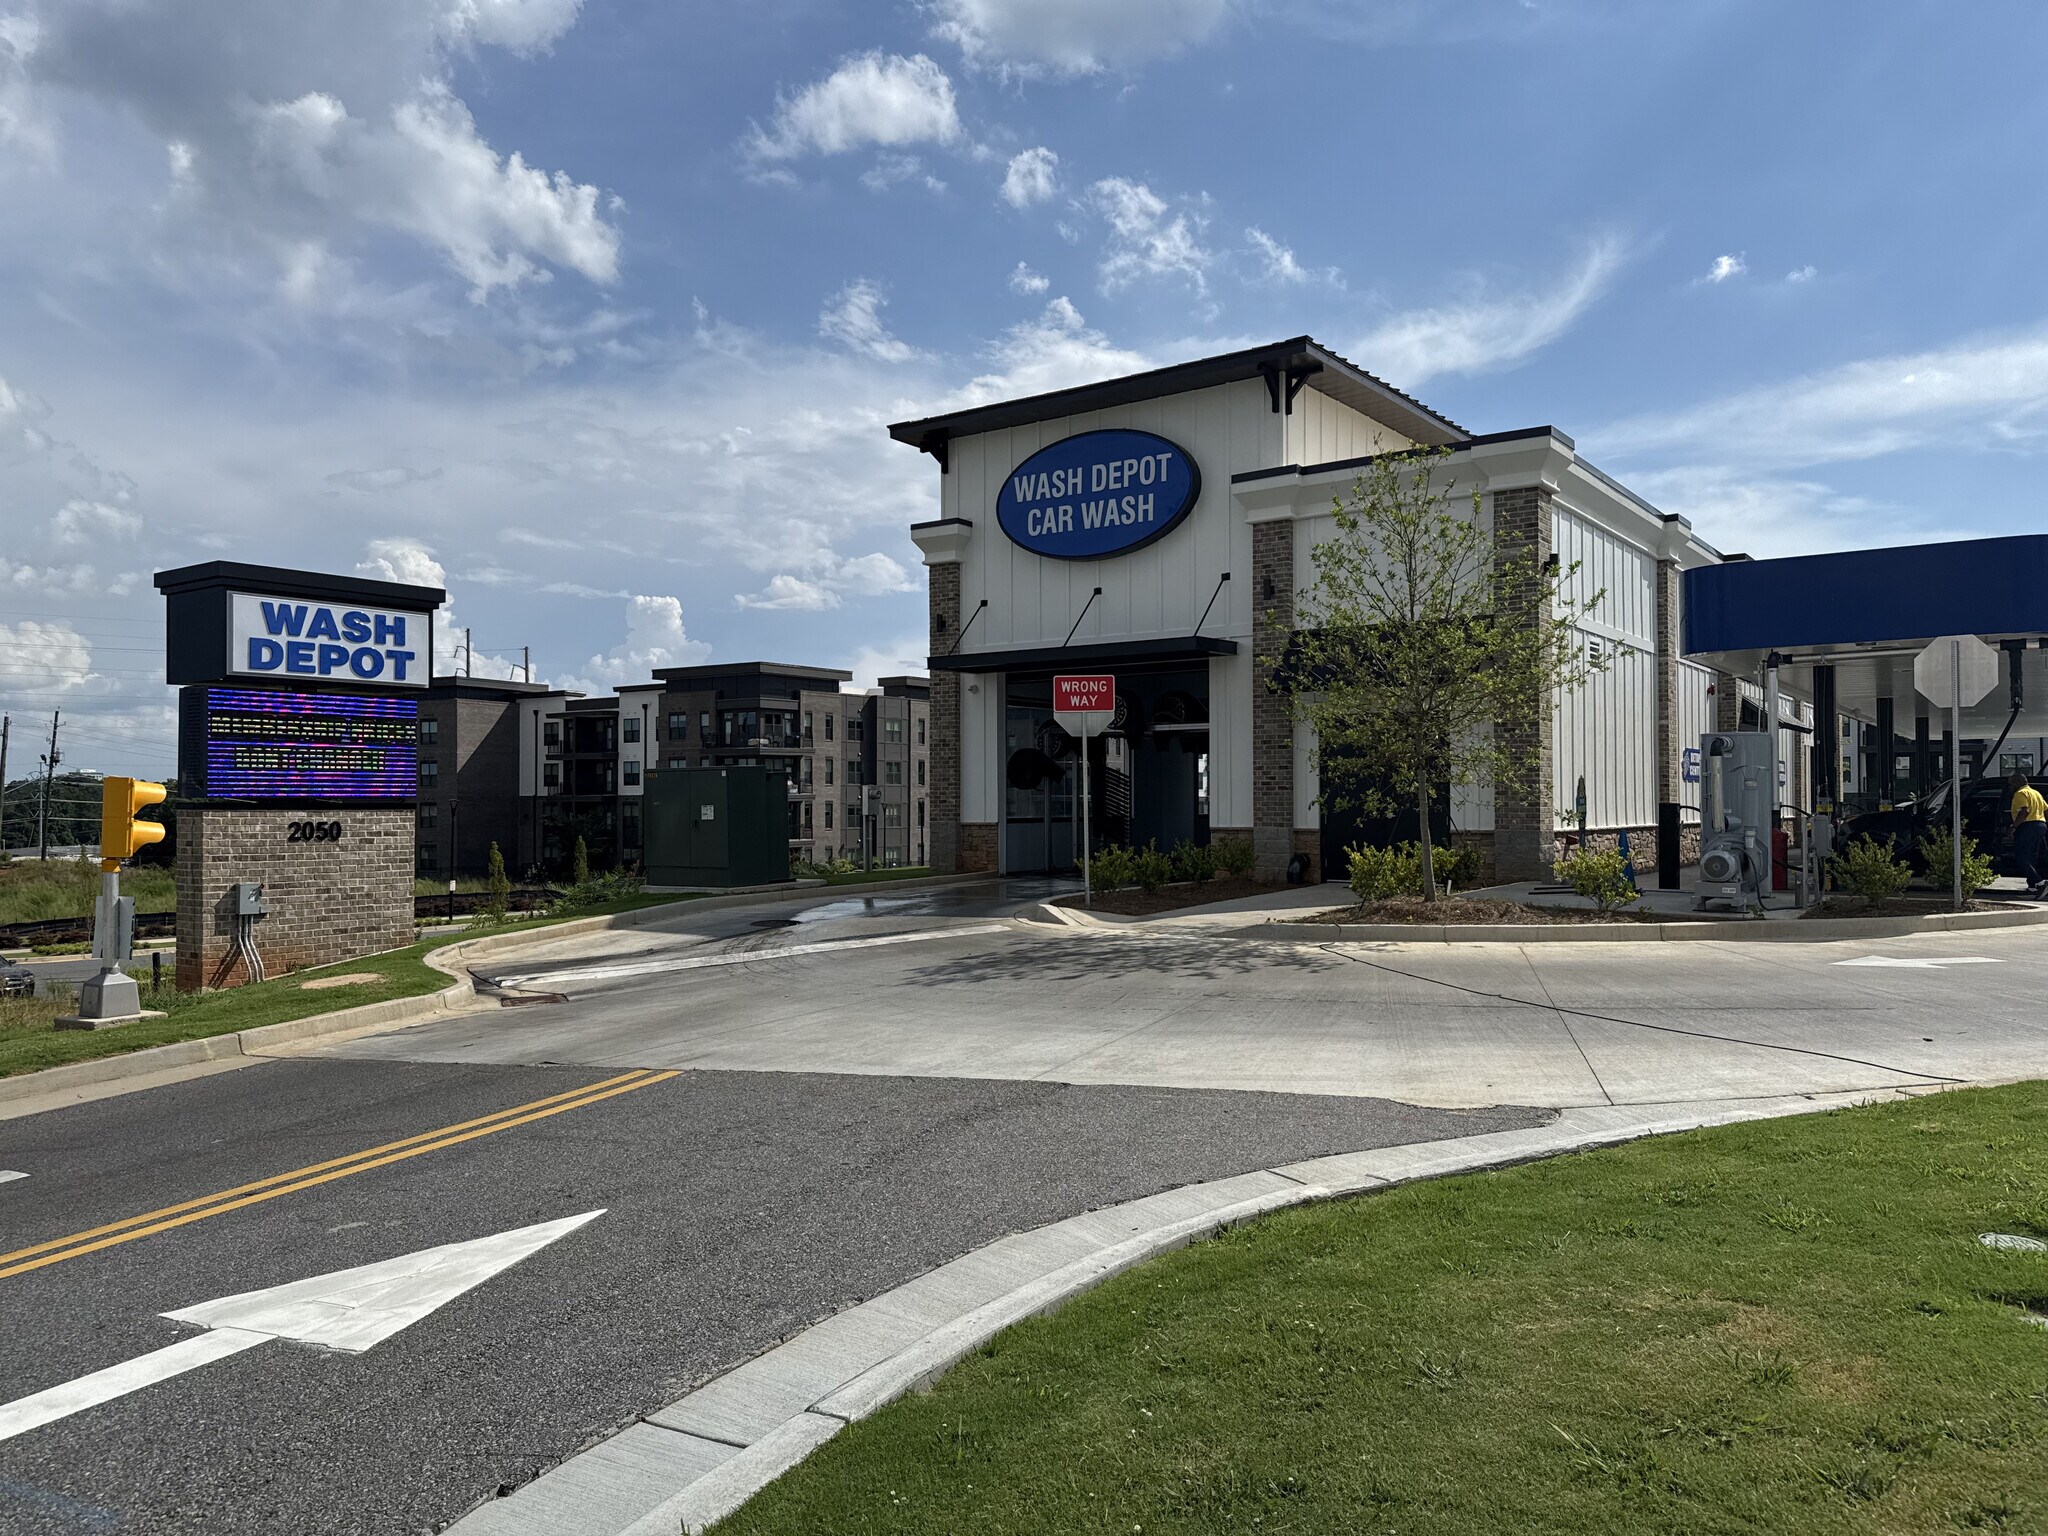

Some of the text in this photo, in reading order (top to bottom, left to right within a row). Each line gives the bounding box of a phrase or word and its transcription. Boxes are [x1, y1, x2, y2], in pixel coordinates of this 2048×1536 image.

[1013, 452, 1173, 503] WASH DEPOT
[1027, 493, 1154, 537] CAR WASH
[260, 601, 406, 647] WASH
[248, 637, 416, 681] DEPOT
[1061, 680, 1108, 693] WRONG
[1070, 695, 1098, 707] WAY
[286, 821, 342, 843] 2050
